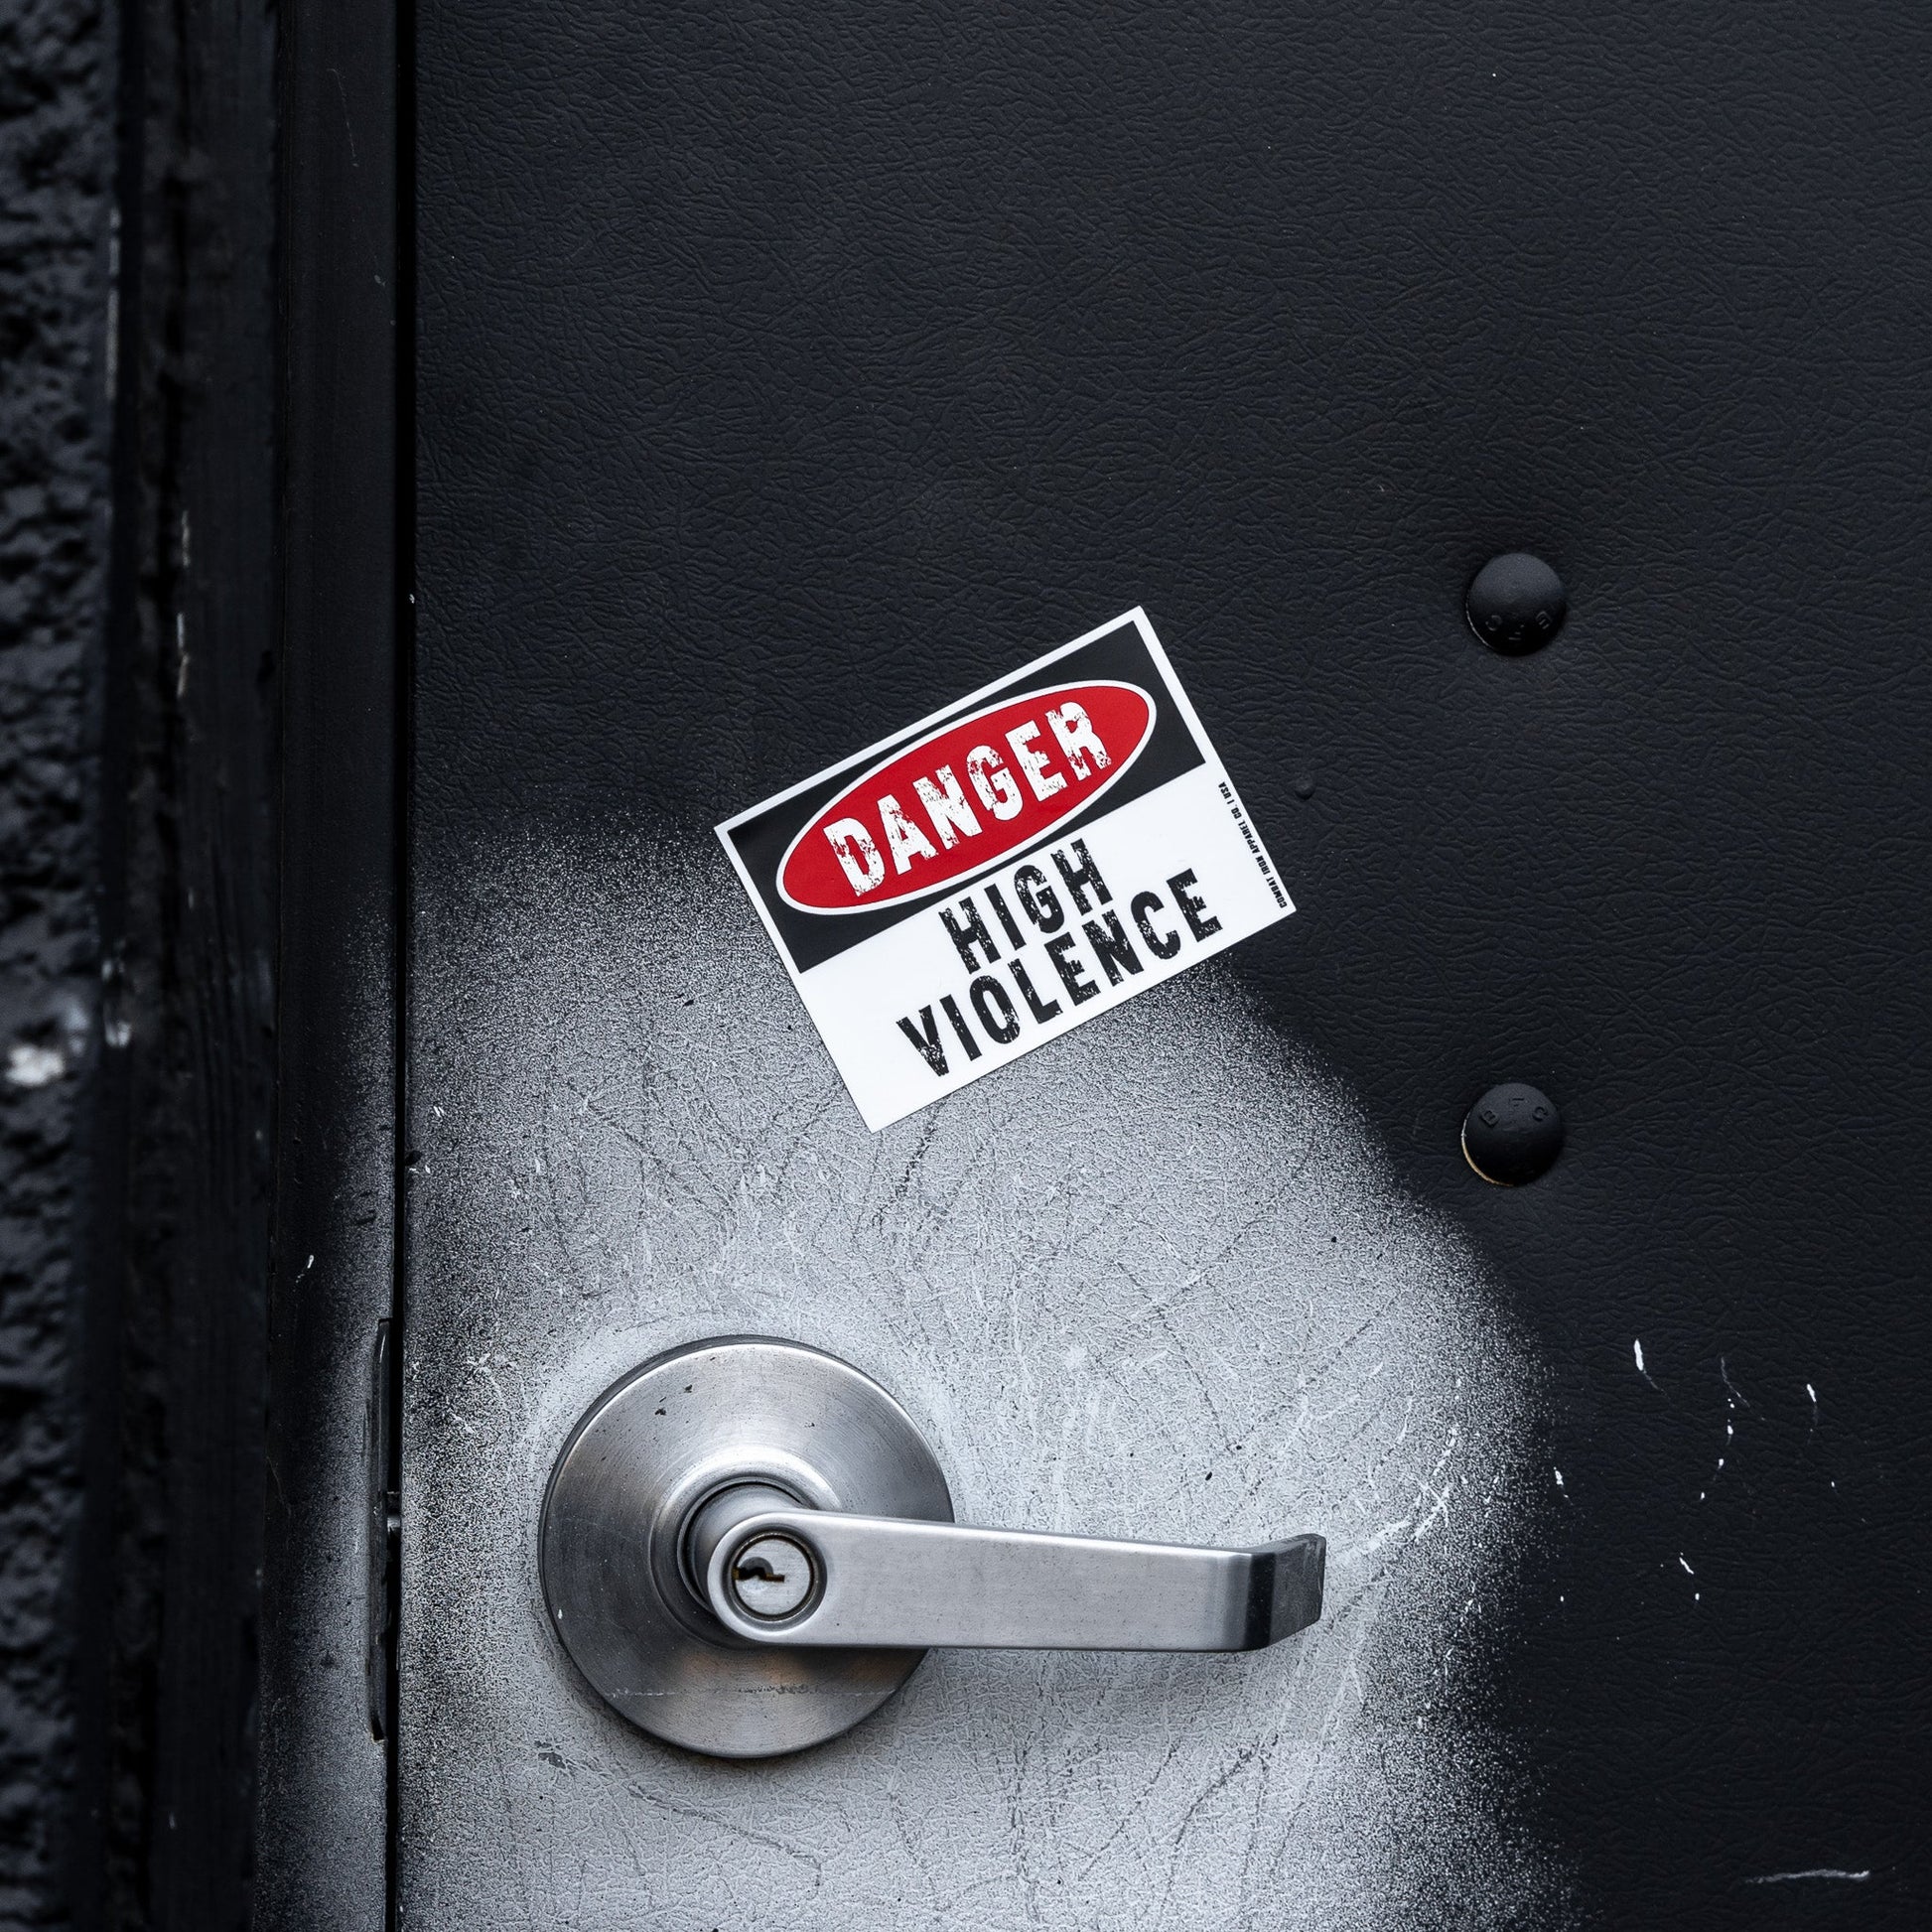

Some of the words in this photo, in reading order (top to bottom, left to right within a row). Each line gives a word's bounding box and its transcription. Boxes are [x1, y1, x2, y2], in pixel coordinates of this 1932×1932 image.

[823, 701, 1112, 897] DANGER
[1217, 781, 1232, 799] USA
[1238, 819, 1260, 854] APPAREL
[1255, 855, 1271, 876] IRON
[938, 838, 1114, 975] HIGH
[1266, 876, 1288, 908] COMBAT
[897, 868, 1223, 1077] VIOLENCE
